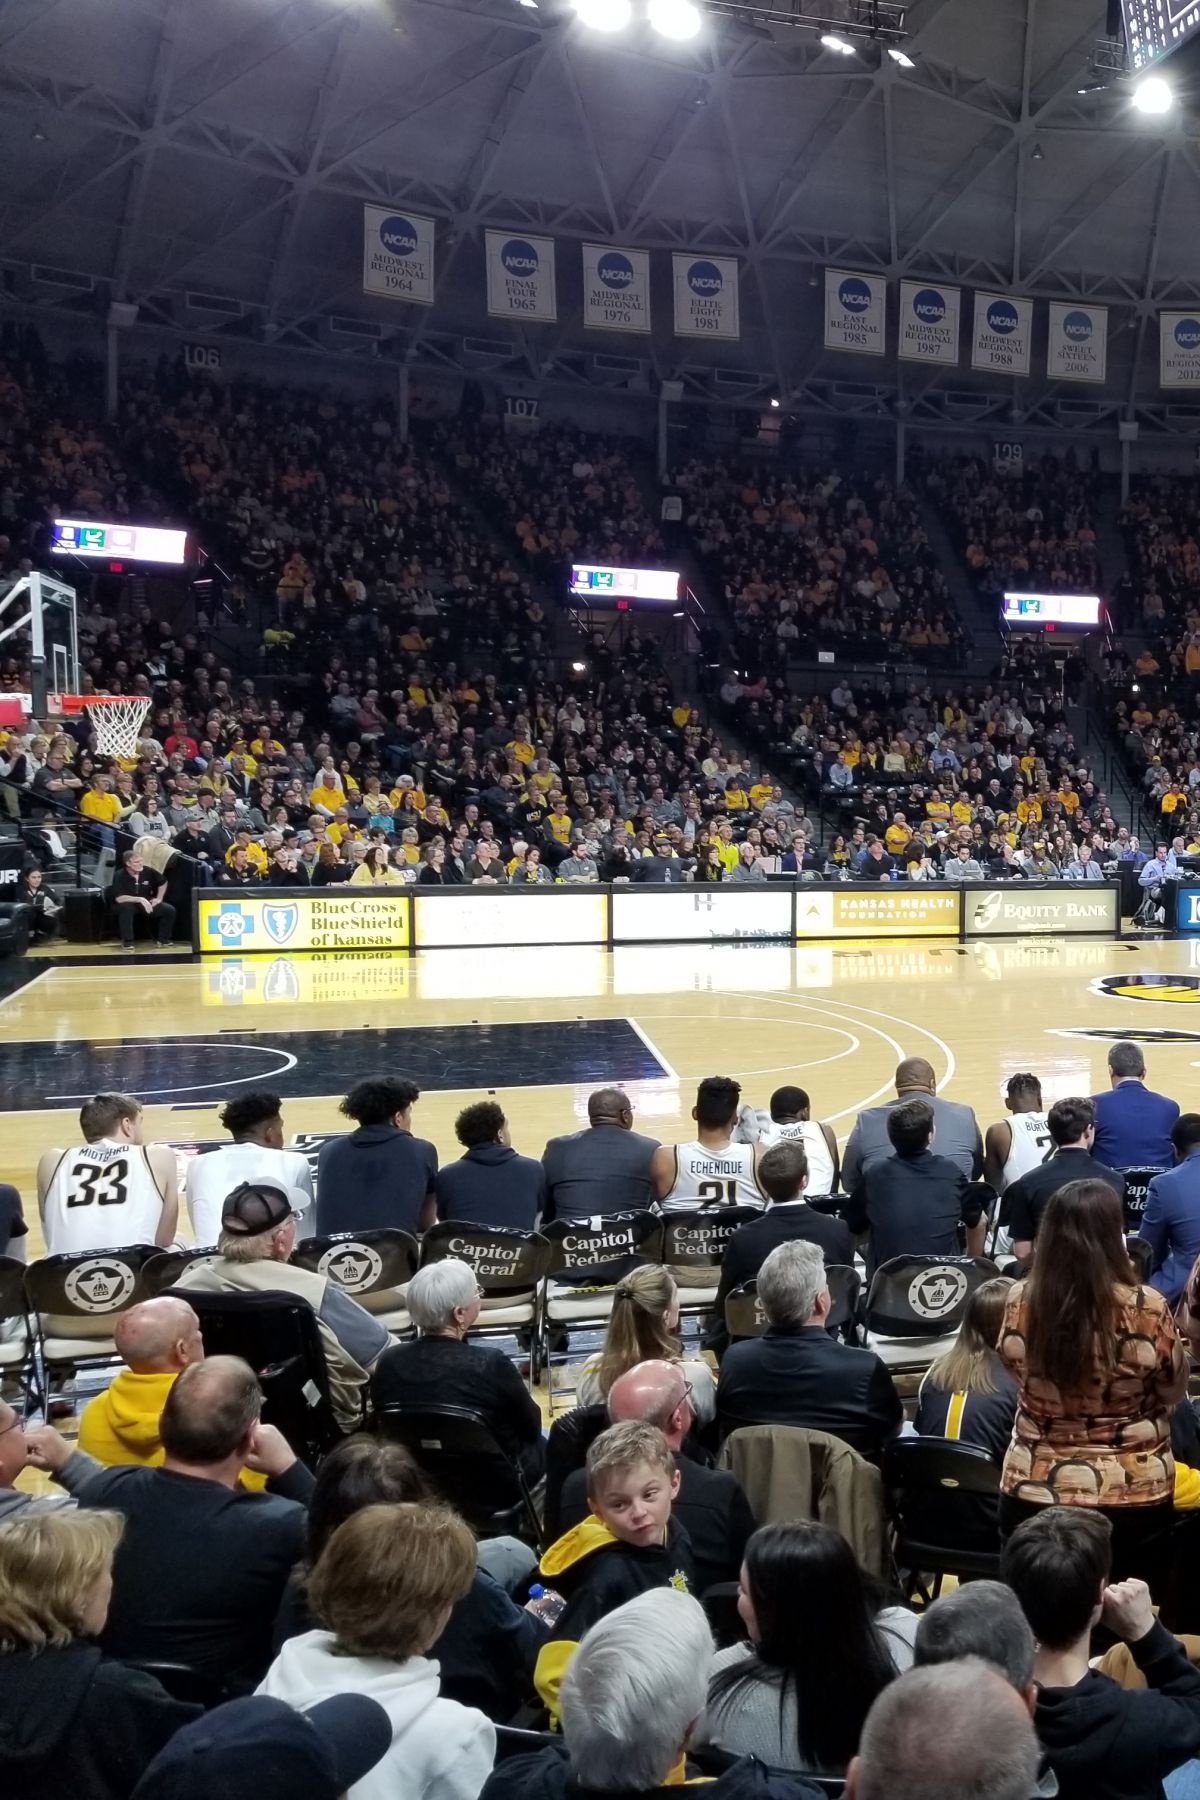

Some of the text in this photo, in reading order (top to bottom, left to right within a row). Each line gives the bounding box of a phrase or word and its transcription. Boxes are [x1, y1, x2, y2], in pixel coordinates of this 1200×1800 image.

[384, 232, 417, 249] NCAA
[373, 253, 425, 271] MIDWEST
[505, 256, 538, 269] NCAA
[371, 261, 428, 281] REGIONAL
[601, 268, 634, 281] NCAA
[385, 276, 413, 291] 1964
[505, 279, 538, 290] FINAL
[691, 277, 723, 289] NCAA
[507, 287, 537, 298] FOUR
[592, 290, 641, 302] MIDWEST
[508, 297, 536, 311] 1965
[590, 297, 644, 310] REGIONAL
[842, 293, 871, 307] NCAA
[604, 310, 631, 322] 1976
[690, 307, 722, 317] EIGHT
[916, 304, 946, 316] NCAA
[694, 317, 719, 329] 1981
[844, 314, 867, 324] EAST
[990, 315, 1018, 328] NCAA
[831, 320, 880, 334] REGIONAL
[908, 323, 950, 336] MIDWEST
[1066, 324, 1093, 336] NCAA
[843, 332, 867, 345] 1985
[905, 331, 952, 344] REGIONAL
[980, 334, 1023, 347] MIDWEST
[916, 342, 941, 355] 1987
[978, 342, 1025, 355] REGIONAL
[184, 345, 219, 366] 106
[989, 352, 1013, 365] 1988
[1057, 351, 1096, 361] SIXTEEN
[1065, 361, 1089, 373] 2006
[1177, 370, 1200, 380] 2012
[505, 397, 538, 418] 107
[993, 442, 1023, 460] 109
[311, 901, 397, 914] BlueCross
[840, 898, 954, 909] KANSAS HEALTH
[840, 911, 927, 919] FOUNDATION
[1004, 903, 1108, 920] EQUITY BANK
[311, 916, 403, 930] BlueShield
[311, 932, 393, 946] of Kansas
[690, 1159, 743, 1175] ECHENIQUE
[66, 1159, 128, 1209] 33
[698, 1180, 737, 1209] 21
[673, 1222, 741, 1241] Capitol
[561, 1227, 635, 1252] Capitol
[448, 1237, 521, 1261] Capitol
[674, 1241, 728, 1256] Feder
[447, 1253, 516, 1277] deral
